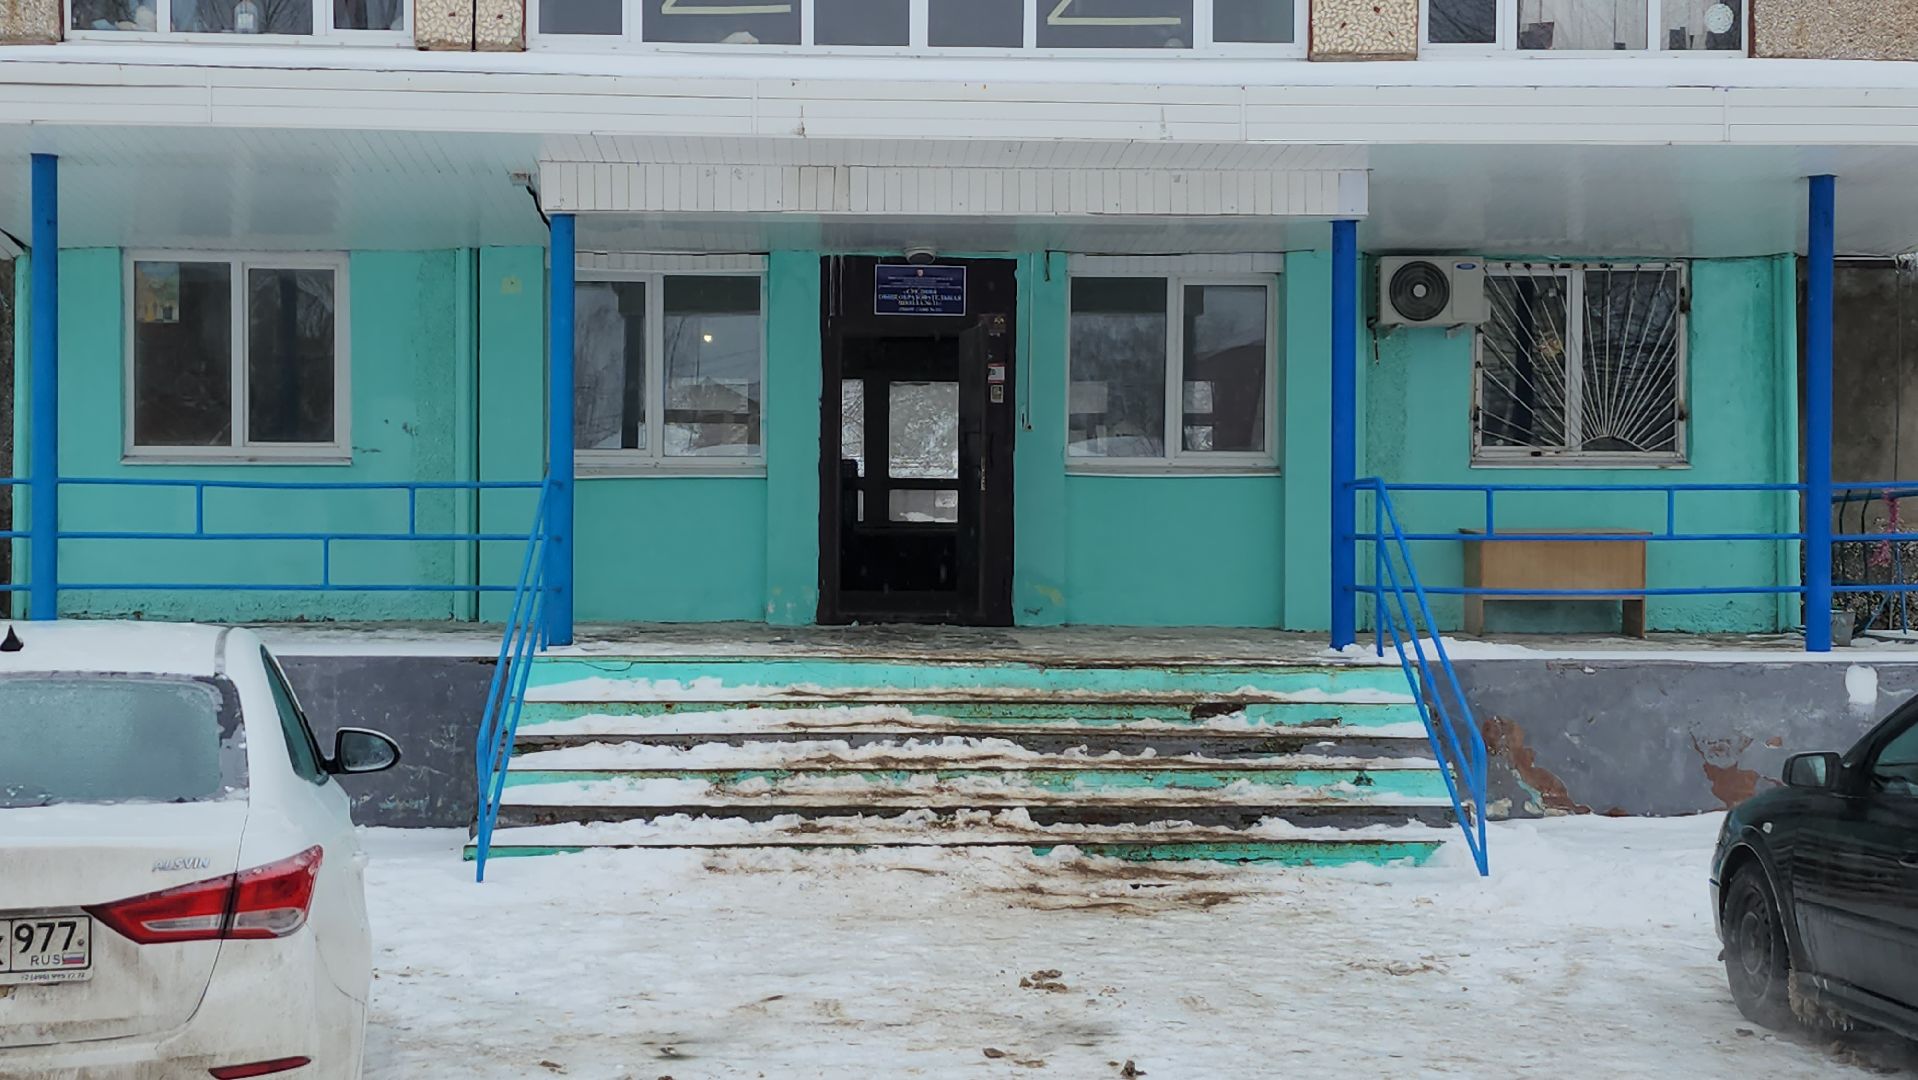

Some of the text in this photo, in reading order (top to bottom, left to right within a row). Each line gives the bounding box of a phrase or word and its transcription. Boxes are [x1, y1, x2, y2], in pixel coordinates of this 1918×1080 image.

[152, 858, 210, 872] ALSVIN
[14, 921, 77, 954] 977
[30, 954, 61, 967] RUS
